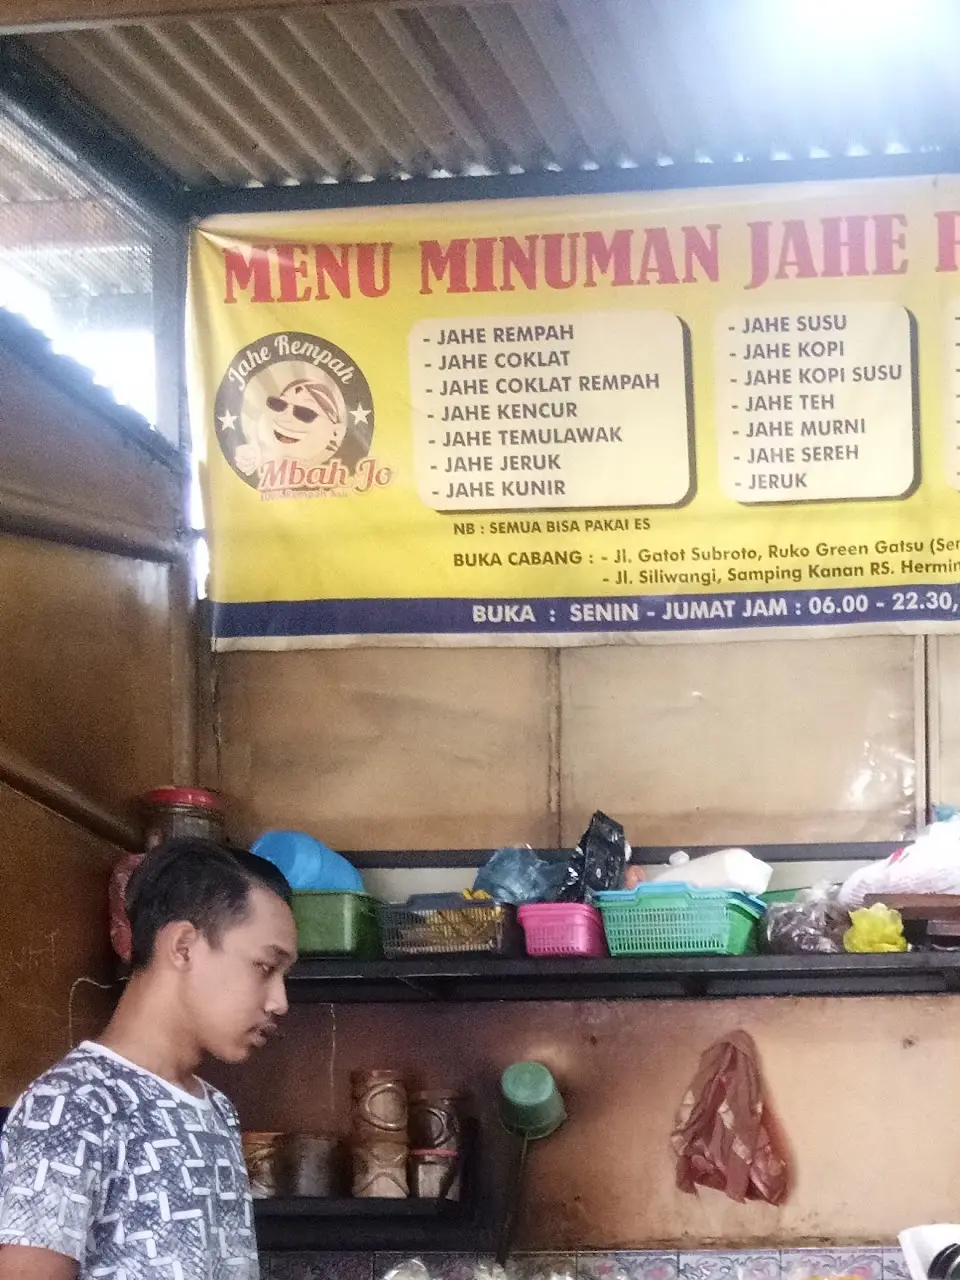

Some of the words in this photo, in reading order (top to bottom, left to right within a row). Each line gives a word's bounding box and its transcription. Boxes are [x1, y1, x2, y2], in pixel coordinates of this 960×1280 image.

[222, 242, 392, 304] MENU
[420, 224, 721, 295] MINUMAN
[744, 215, 908, 289] JAHE
[742, 317, 791, 333] JAHE
[796, 315, 847, 332] SUSU
[438, 327, 487, 345] JAHE
[493, 324, 574, 342] REMPAH
[743, 343, 791, 359] JAHE
[798, 342, 845, 357] KOPI
[228, 346, 271, 392] Jahe
[274, 335, 353, 384] Rempah
[439, 353, 488, 371] JAHE
[494, 351, 570, 368] COKLAT
[441, 379, 489, 396] JAHE
[495, 377, 573, 394] COKLAT
[579, 373, 660, 392] REMPAH
[744, 369, 793, 385] JAHE
[799, 367, 846, 383] KOPI
[852, 365, 902, 381] SUSU
[442, 405, 491, 423] JAHE
[498, 402, 578, 420] KENCUR
[745, 396, 794, 412] JAHE
[800, 394, 835, 410] TEH
[443, 430, 493, 447] JAHE
[498, 426, 623, 445] TEMULAWAK
[746, 421, 794, 437] JAHE
[800, 419, 866, 436] MURNI
[445, 456, 494, 473] JAHE
[500, 453, 561, 471] JERUK
[748, 447, 795, 463] JAHE
[801, 445, 859, 462] SEREH
[258, 459, 349, 489] Mbah
[356, 459, 391, 492] Jo
[748, 473, 807, 490] JERUK
[446, 481, 495, 498] JAHE
[502, 479, 565, 497] KUNIR
[453, 522, 475, 535] NB
[490, 520, 542, 535] SEMUA
[547, 520, 581, 533] BISA
[585, 519, 629, 532] PAKAI
[634, 519, 650, 531] ES
[453, 552, 502, 567] BUKA
[508, 550, 582, 566] CABANG
[638, 547, 685, 564] Gatot
[691, 545, 763, 562] Subroto,
[768, 543, 810, 558] Ruko
[815, 543, 868, 558] Green
[875, 539, 924, 554] Gatsu
[639, 568, 722, 588] Siliwangi,
[728, 566, 802, 585] Samping
[808, 564, 864, 580] Kanan
[870, 562, 895, 576] RS.
[473, 605, 535, 624] BUKA
[570, 604, 638, 622] SENIN
[662, 601, 735, 619] JUMAT
[742, 598, 788, 618] JAM
[809, 596, 868, 614] 06.00
[892, 592, 958, 612] 22.30,
